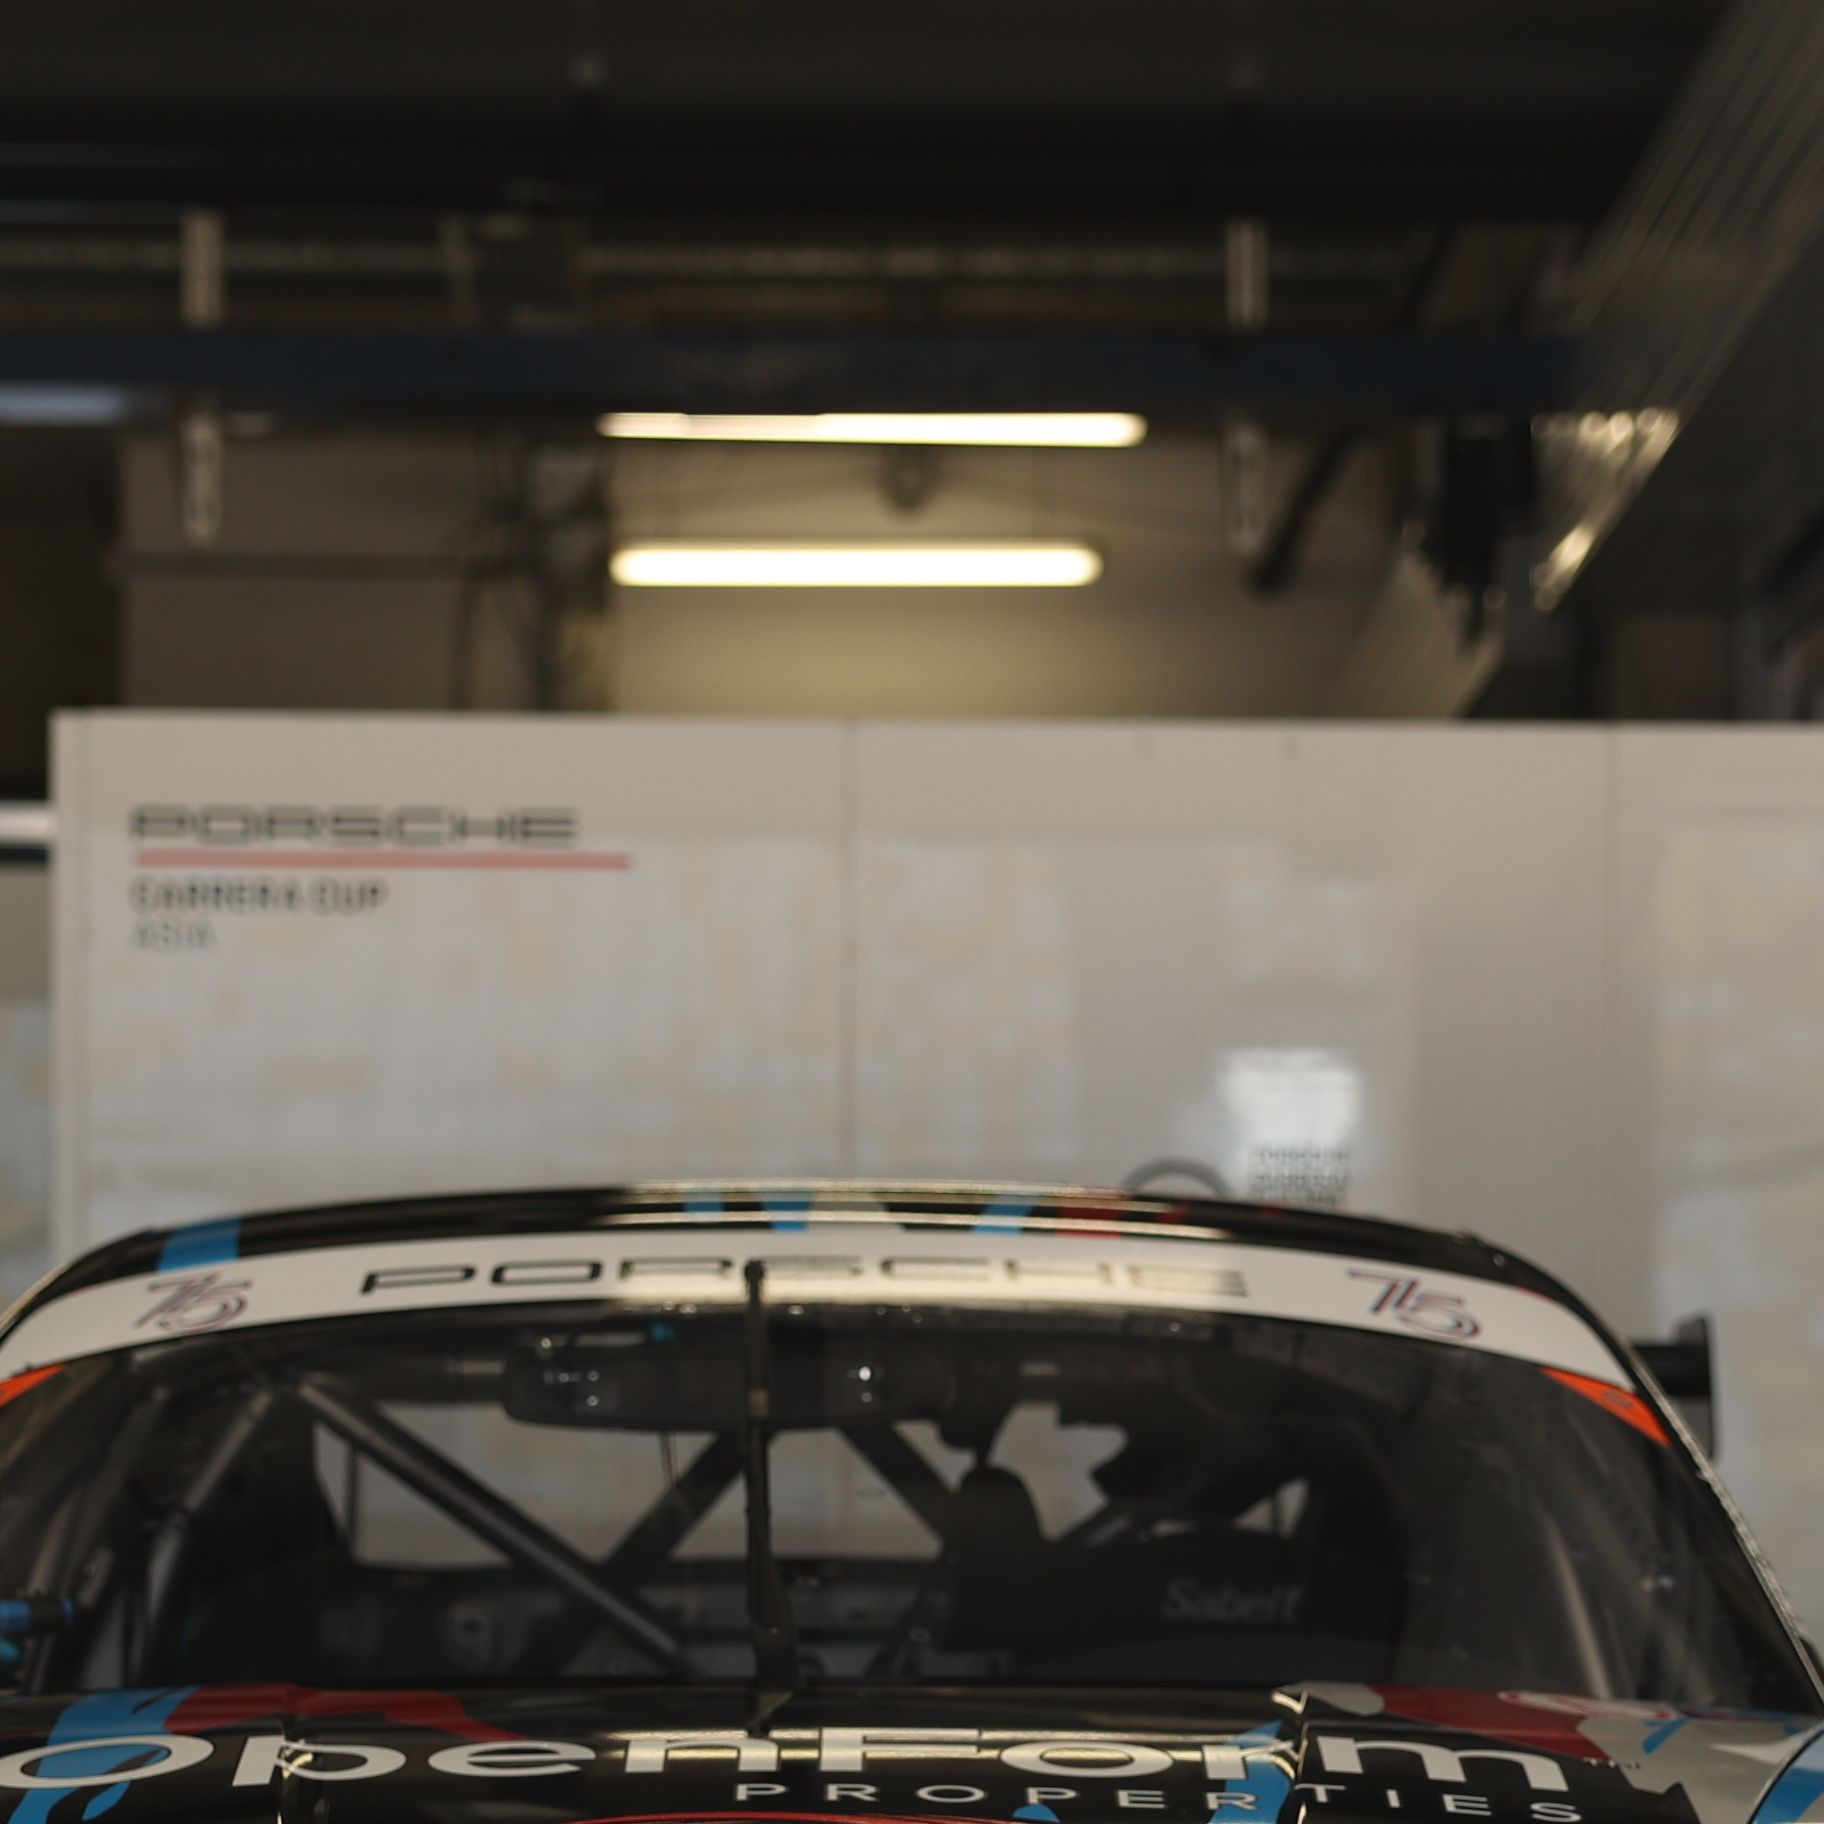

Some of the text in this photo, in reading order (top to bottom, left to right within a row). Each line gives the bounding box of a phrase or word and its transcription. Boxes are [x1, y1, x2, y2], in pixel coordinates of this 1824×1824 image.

[130, 807, 578, 846] PORSCHE
[128, 874, 389, 915] CARRERA CUP
[361, 1257, 1247, 1298] PORSCHE
[736, 1783, 1581, 1824] PROPERTIES
